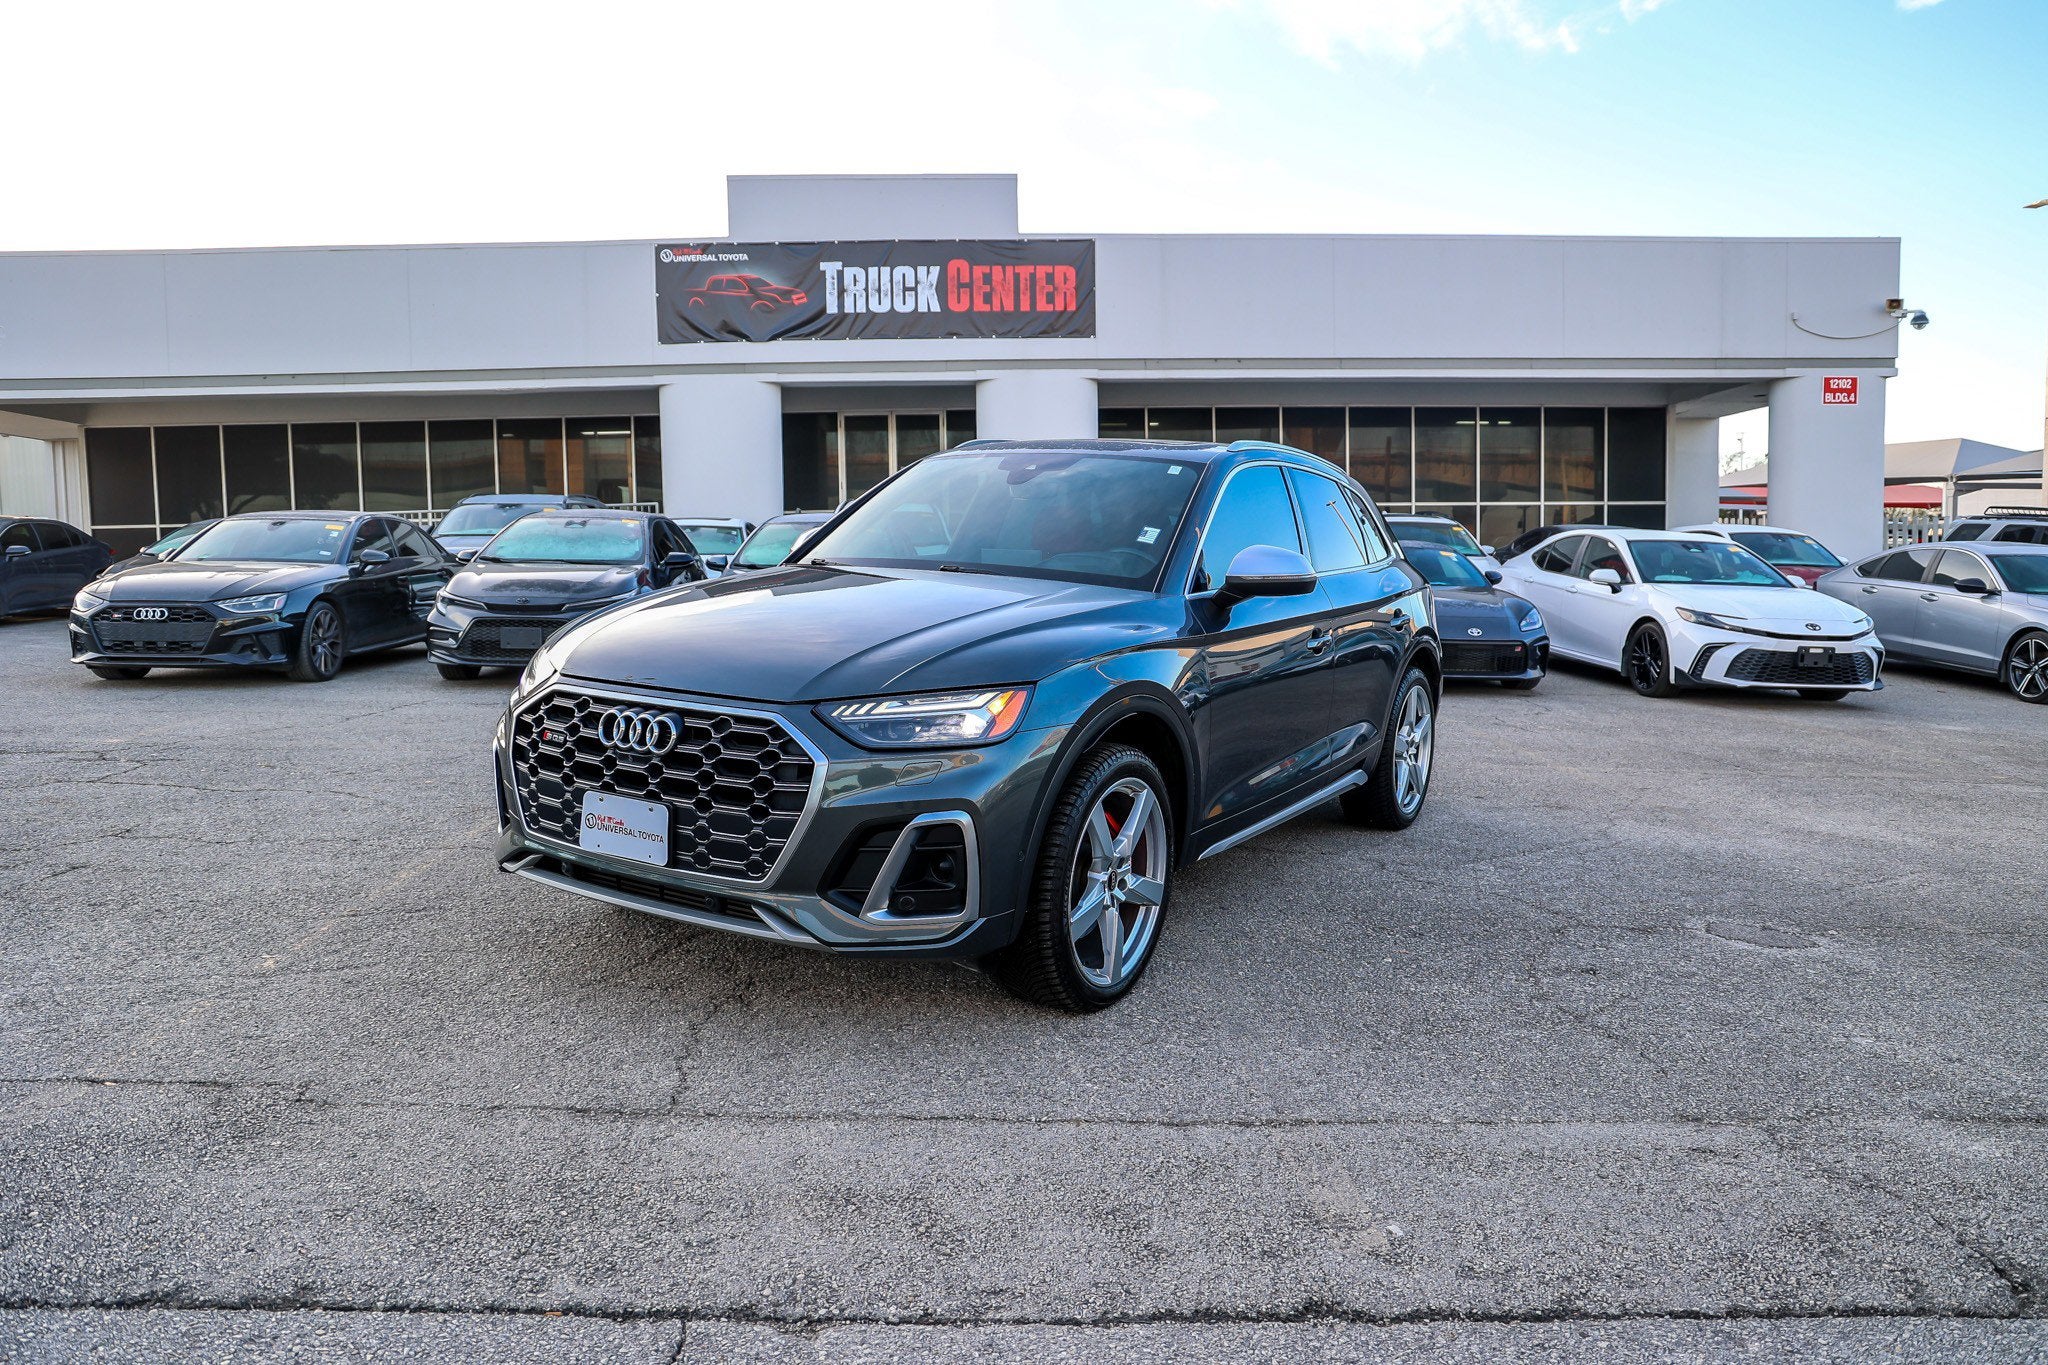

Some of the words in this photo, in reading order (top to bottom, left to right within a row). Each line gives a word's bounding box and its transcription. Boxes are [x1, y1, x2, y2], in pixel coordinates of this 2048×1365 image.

[673, 254, 717, 262] UNIVERSAL
[718, 253, 749, 261] TOYOTA
[820, 261, 941, 314] TRUCK
[947, 258, 1076, 312] CENTER
[1830, 379, 1852, 389] 12102
[597, 823, 637, 838] UNIVERSAL
[638, 830, 664, 843] TOYOTA
